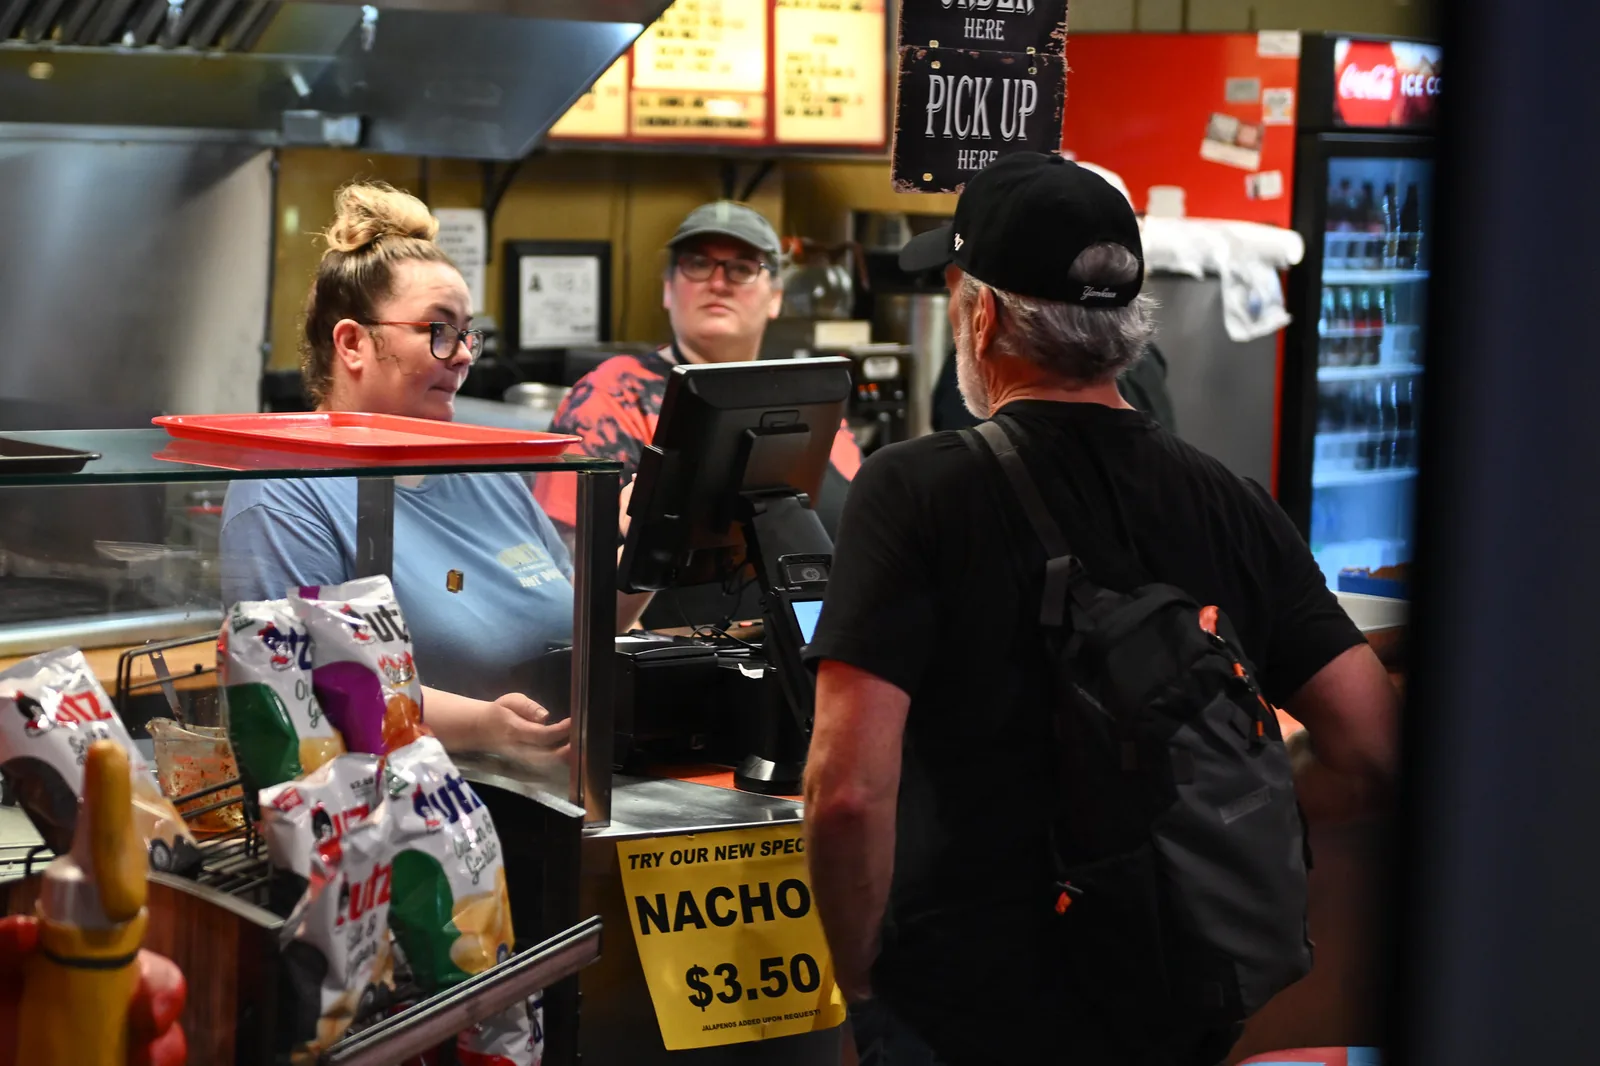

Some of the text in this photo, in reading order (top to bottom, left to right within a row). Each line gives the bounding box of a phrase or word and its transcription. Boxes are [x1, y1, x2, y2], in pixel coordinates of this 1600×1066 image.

[964, 17, 1006, 41] HERE
[1400, 73, 1424, 96] ICE
[925, 74, 993, 140] PICK
[1000, 78, 1038, 141] UP
[628, 852, 665, 870] TRY
[670, 847, 709, 866] OUR
[714, 843, 756, 861] NEW
[634, 878, 811, 936] NACHO
[685, 953, 820, 1012] $3.50
[702, 1022, 737, 1031] JALAPENOS
[738, 1018, 761, 1027] ADDED
[762, 1015, 782, 1024] UPON
